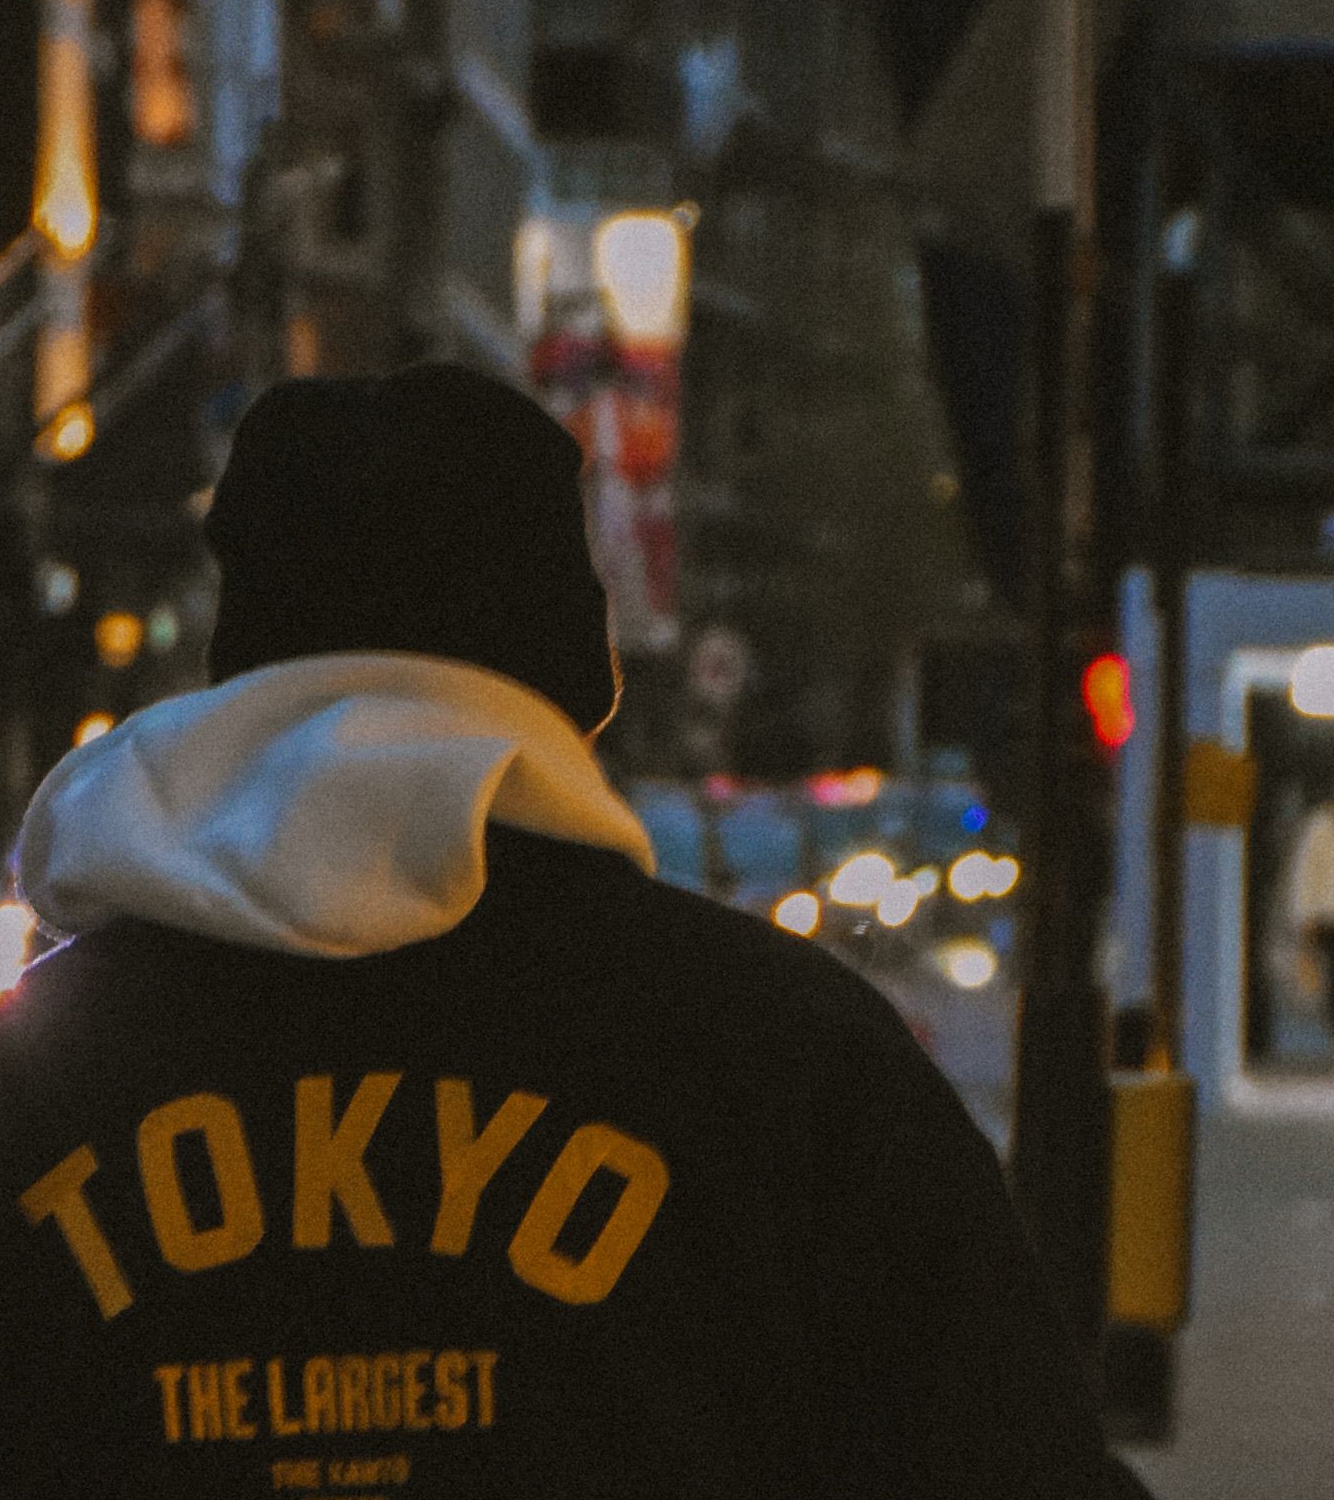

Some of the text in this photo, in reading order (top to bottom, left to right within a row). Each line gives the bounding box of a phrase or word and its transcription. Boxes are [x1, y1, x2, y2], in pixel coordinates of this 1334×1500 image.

[20, 1072, 670, 1319] TOKYO
[154, 1350, 498, 1442] THE LARGEST
